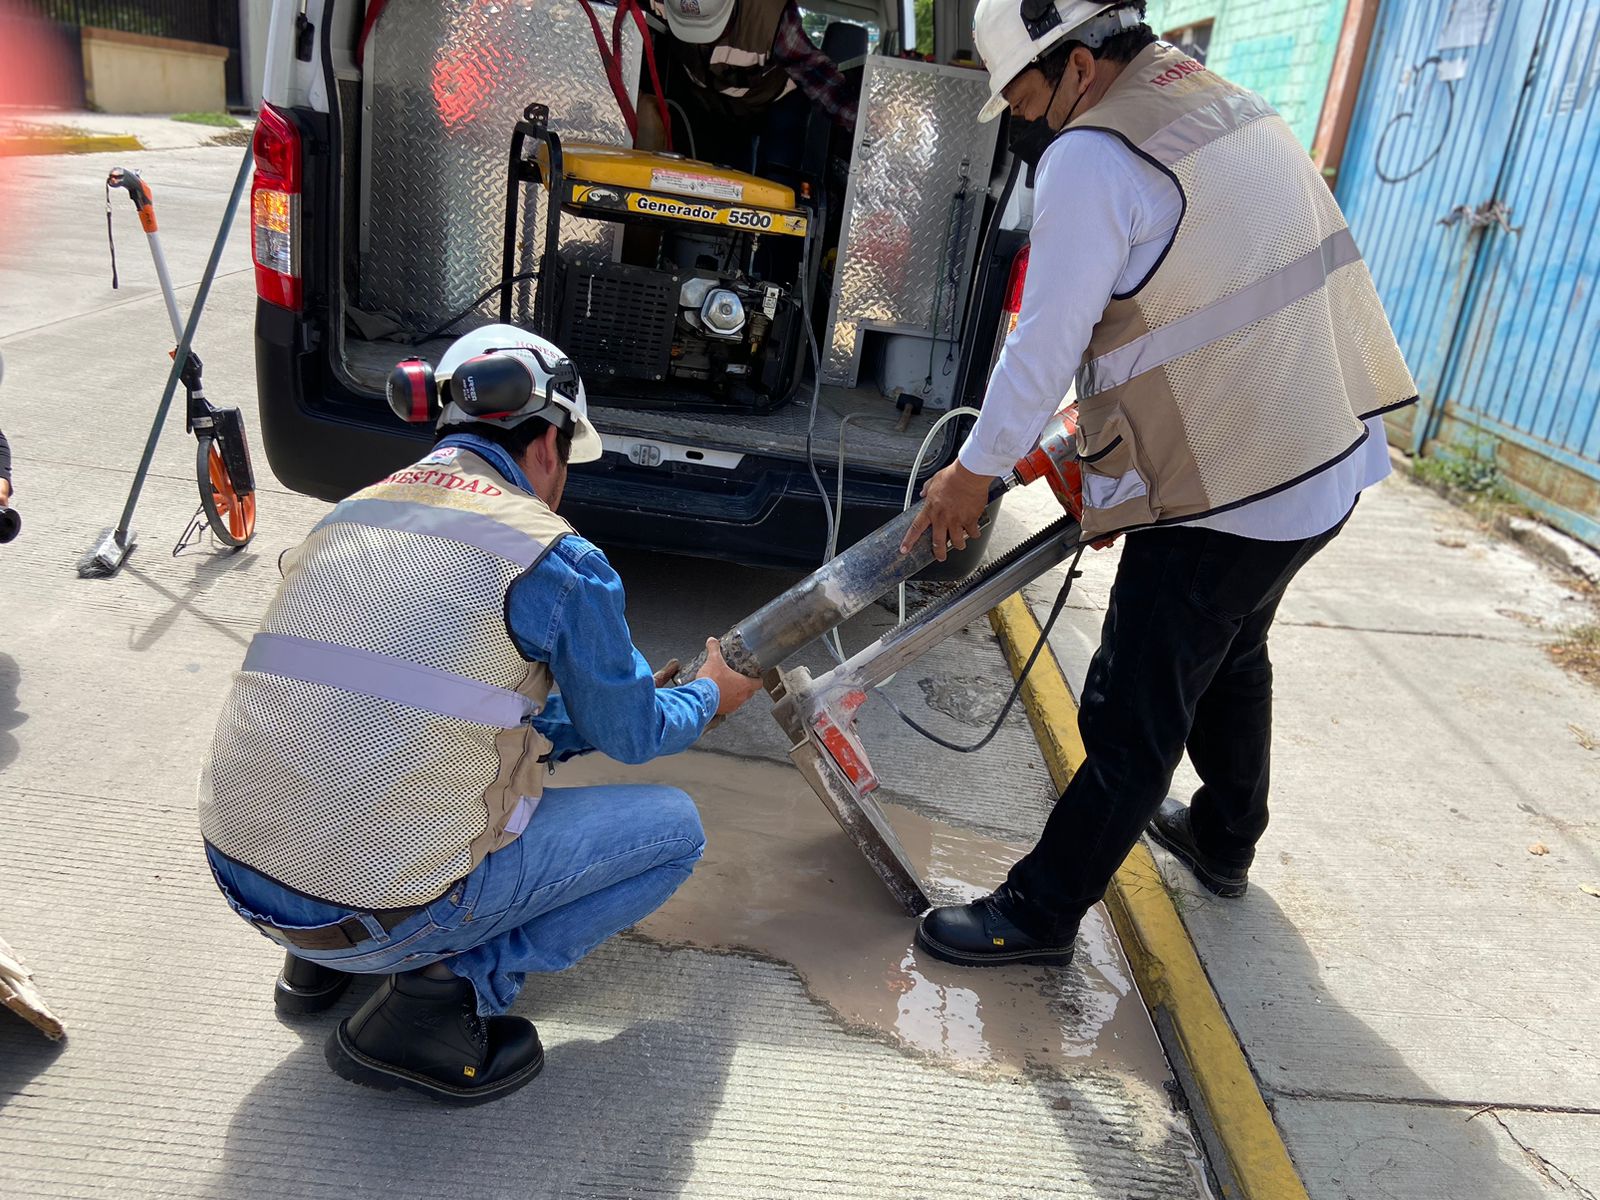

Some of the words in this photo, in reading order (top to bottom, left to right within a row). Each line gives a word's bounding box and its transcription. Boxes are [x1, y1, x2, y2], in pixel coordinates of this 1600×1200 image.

[637, 197, 717, 220] Generador
[728, 210, 771, 229] 5500
[379, 469, 502, 497] NESTIDAD
